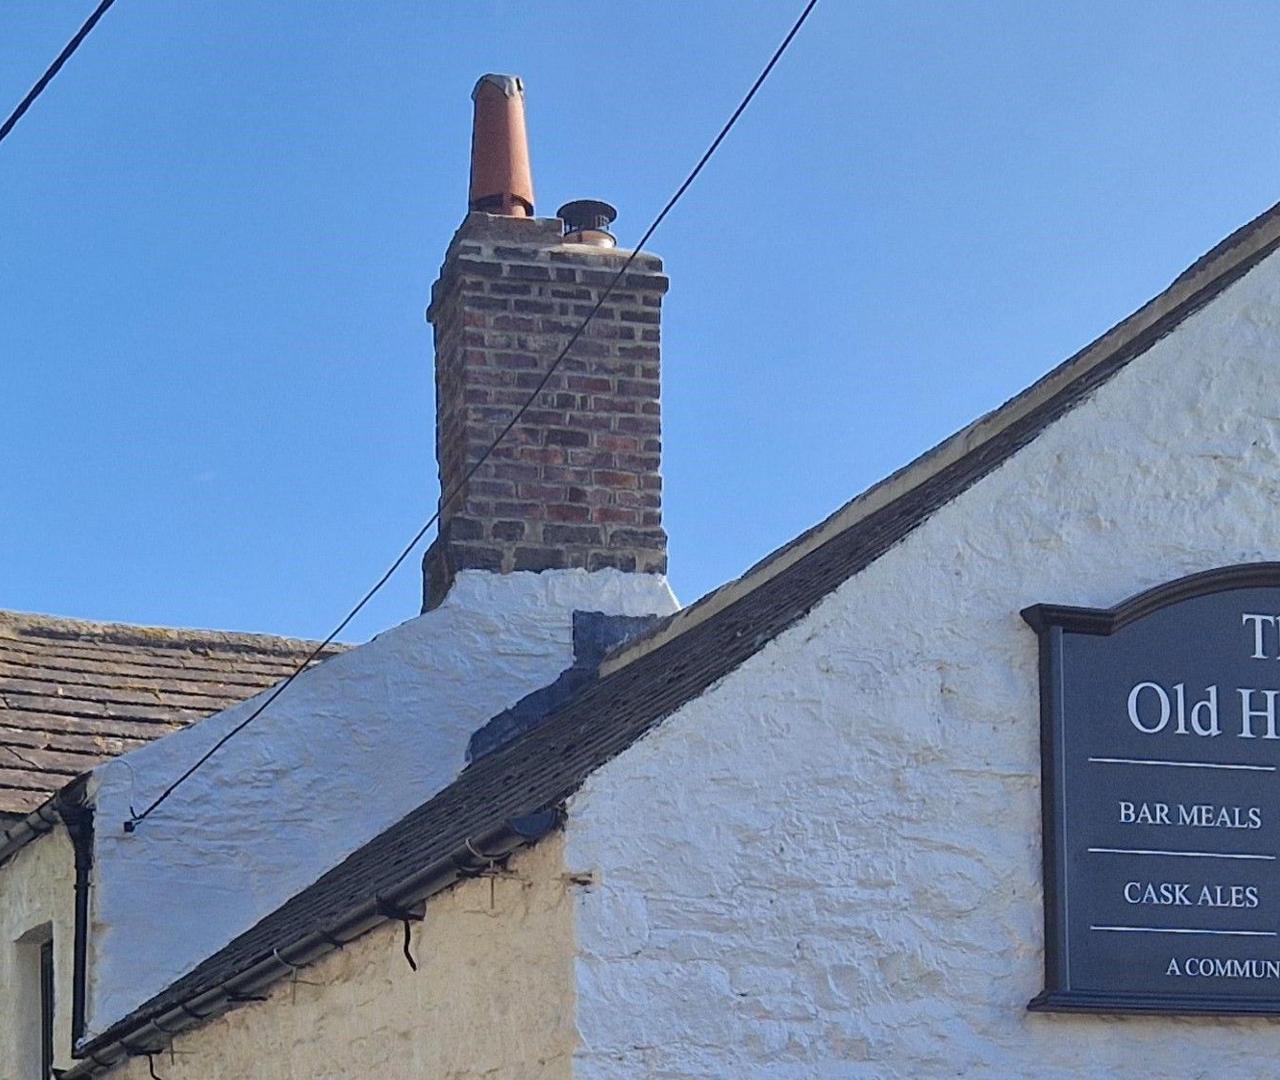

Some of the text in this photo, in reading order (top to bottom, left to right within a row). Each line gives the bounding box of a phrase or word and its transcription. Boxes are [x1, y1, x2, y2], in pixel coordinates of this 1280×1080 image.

[1127, 681, 1222, 737] Old
[1119, 801, 1262, 829] BAR MEALS
[1124, 882, 1259, 908] CASK ALES
[1166, 957, 1182, 976] A
